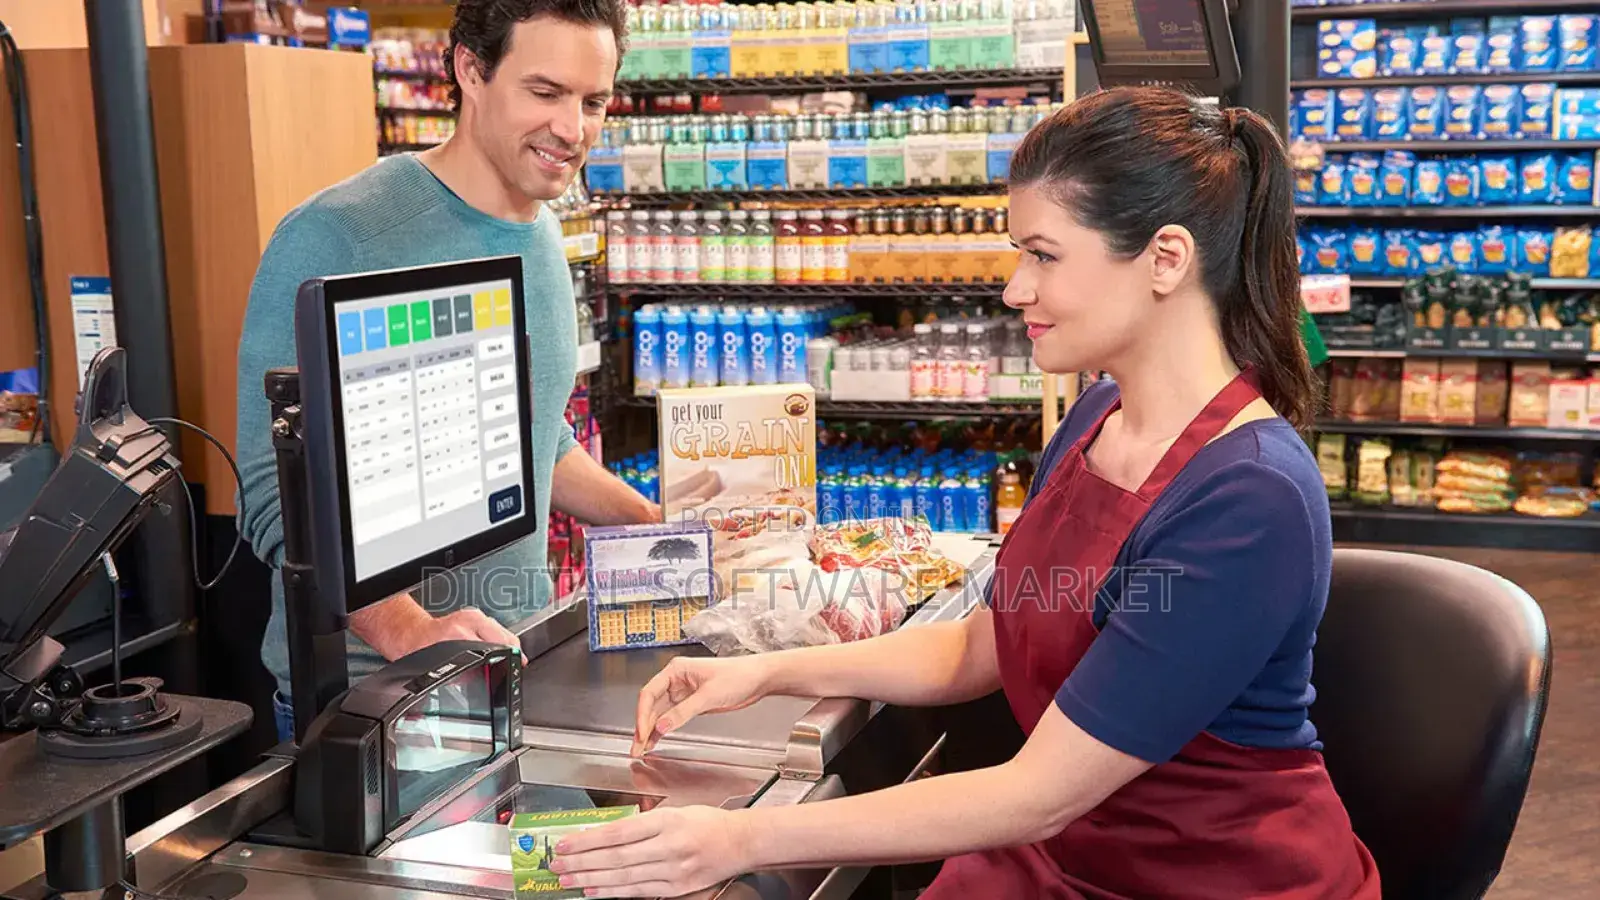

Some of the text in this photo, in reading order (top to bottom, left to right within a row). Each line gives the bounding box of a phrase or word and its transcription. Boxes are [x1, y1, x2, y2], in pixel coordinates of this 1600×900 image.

[639, 330, 653, 367] ZICO
[666, 330, 680, 368] ZICO
[694, 331, 708, 368] ZICO
[723, 331, 737, 369] ZICO
[752, 332, 766, 370] ZICO
[781, 332, 796, 370] ZICO
[671, 402, 724, 424] get your
[670, 417, 809, 461] GRAIN
[774, 454, 809, 488] ON!
[496, 495, 514, 513] ENTER
